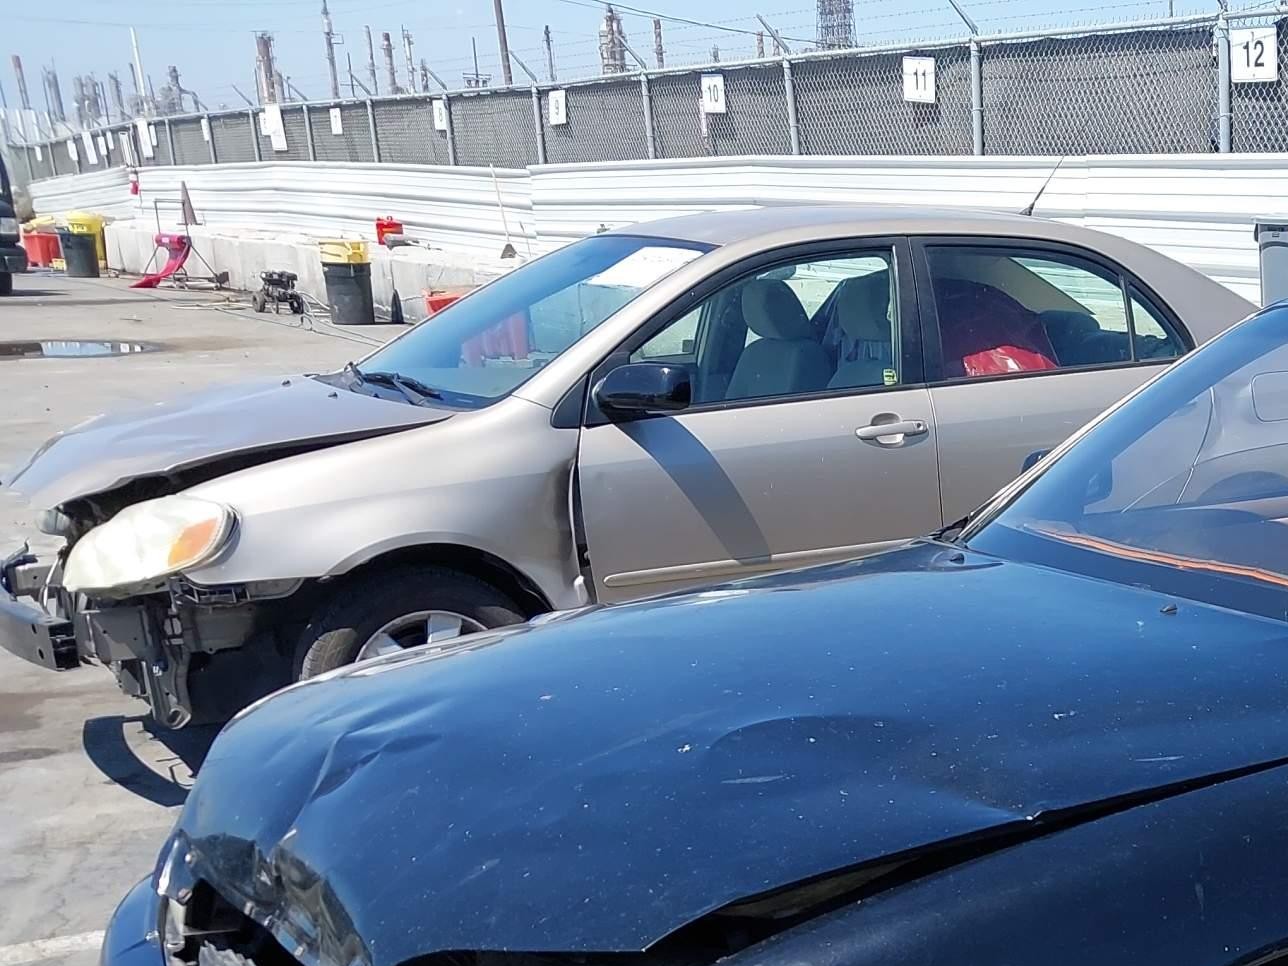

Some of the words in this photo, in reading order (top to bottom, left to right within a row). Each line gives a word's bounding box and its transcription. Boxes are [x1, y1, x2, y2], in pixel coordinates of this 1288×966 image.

[1243, 40, 1265, 68] 12
[913, 68, 927, 91] 11
[707, 83, 719, 103] 10
